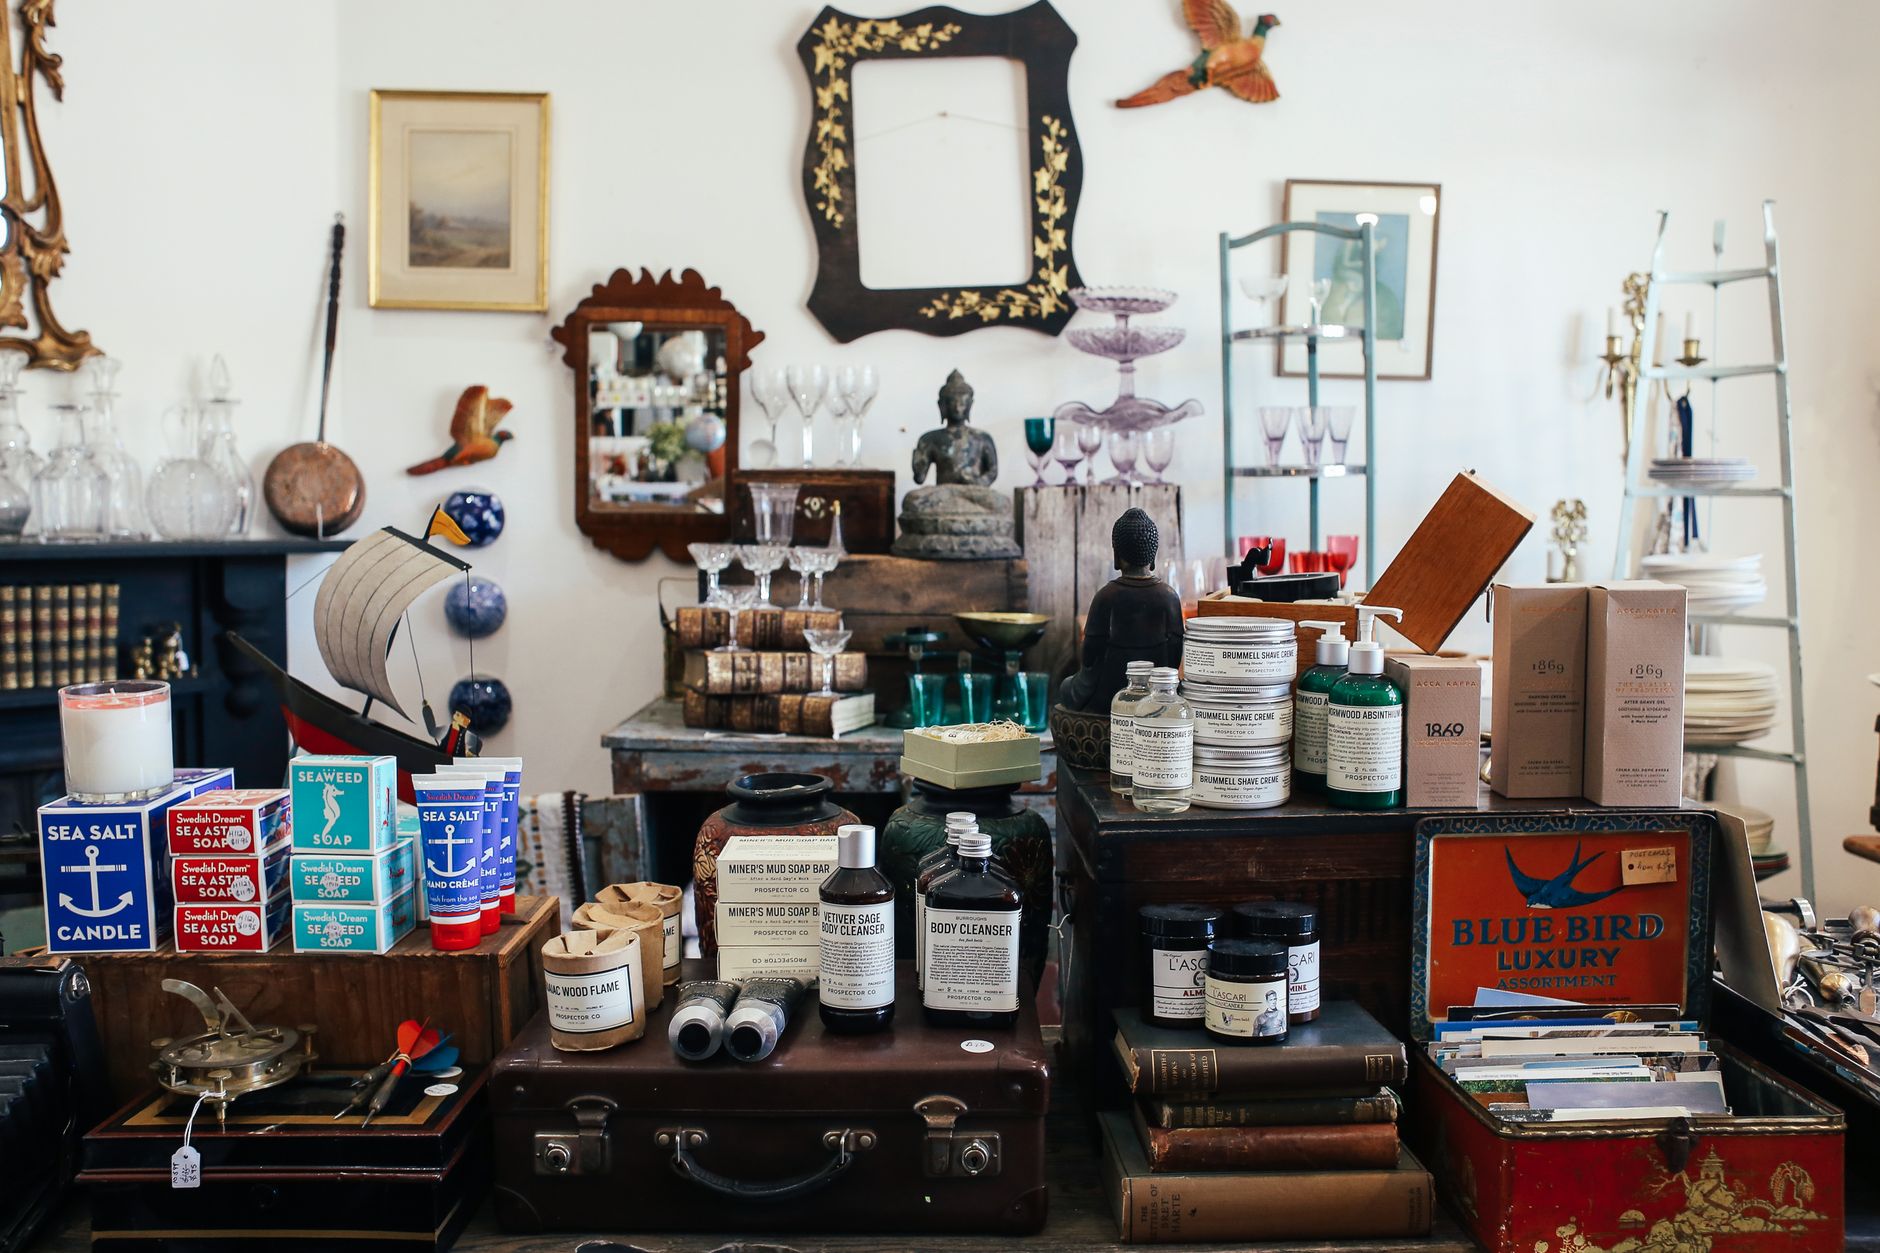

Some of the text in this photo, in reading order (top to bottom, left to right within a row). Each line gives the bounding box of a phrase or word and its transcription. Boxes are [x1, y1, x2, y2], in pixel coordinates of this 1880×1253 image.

[1262, 651, 1280, 659] SHAVE
[1281, 650, 1294, 658] CREME
[1532, 660, 1564, 674] 1869
[1630, 664, 1663, 678] 1869
[1196, 711, 1229, 720] BRUMMELL
[1254, 712, 1274, 720] CREME
[1425, 723, 1464, 737] 1869
[298, 770, 362, 783] SEAWEED
[1139, 771, 1178, 779] PROSPECTOR
[1200, 775, 1236, 785] BRUMMELL
[1260, 775, 1279, 785] CREME
[502, 792, 515, 801] LT
[484, 802, 498, 812] LT
[177, 812, 210, 823] Swedish
[423, 811, 480, 822] SEA SALT
[48, 824, 136, 841] SEA SALT
[176, 826, 230, 836] SEA AST
[193, 838, 228, 848] SOAP
[313, 834, 352, 846] SOAP
[182, 862, 216, 873] Swedish
[301, 862, 364, 873] Swedish Dream
[729, 864, 829, 874] MINER'S MUD SOAP BAR
[182, 875, 206, 886] SEA
[304, 875, 361, 886] SEEED
[427, 878, 479, 889] HAND CRÈME
[317, 889, 349, 898] SOAP
[457, 894, 468, 902] the
[184, 910, 237, 921] Swedish Dre
[303, 911, 368, 922] Swedish Dream
[729, 907, 763, 916] MINER'S
[766, 907, 785, 916] MUD
[788, 907, 810, 916] SOAP
[824, 911, 855, 924] VETIVER
[858, 913, 880, 924] SAGE
[57, 924, 142, 941] CANDLE
[184, 923, 237, 933] SEA AST
[308, 925, 364, 935] SEEED
[822, 922, 885, 935] BODY CLEANSER
[931, 922, 1012, 936] BODY CLEANSER
[1452, 914, 1664, 946] BLUE BIRD
[200, 935, 237, 945] SOAP
[320, 938, 352, 947] SOAP
[1170, 958, 1207, 971] L'ASC
[1289, 952, 1314, 966] CARI
[1497, 947, 1621, 971] LUXURY
[1498, 974, 1617, 990] ASSORTMENT
[562, 987, 588, 997] WOOD
[590, 981, 620, 995] FLAME
[1290, 984, 1307, 992] MINE
[1213, 989, 1247, 1001] L'ASCARI
[1151, 1184, 1158, 1197] OF
[1140, 1206, 1148, 1224] THE
[1161, 1198, 1169, 1229] BRET
[1172, 1193, 1181, 1232] HARTE
